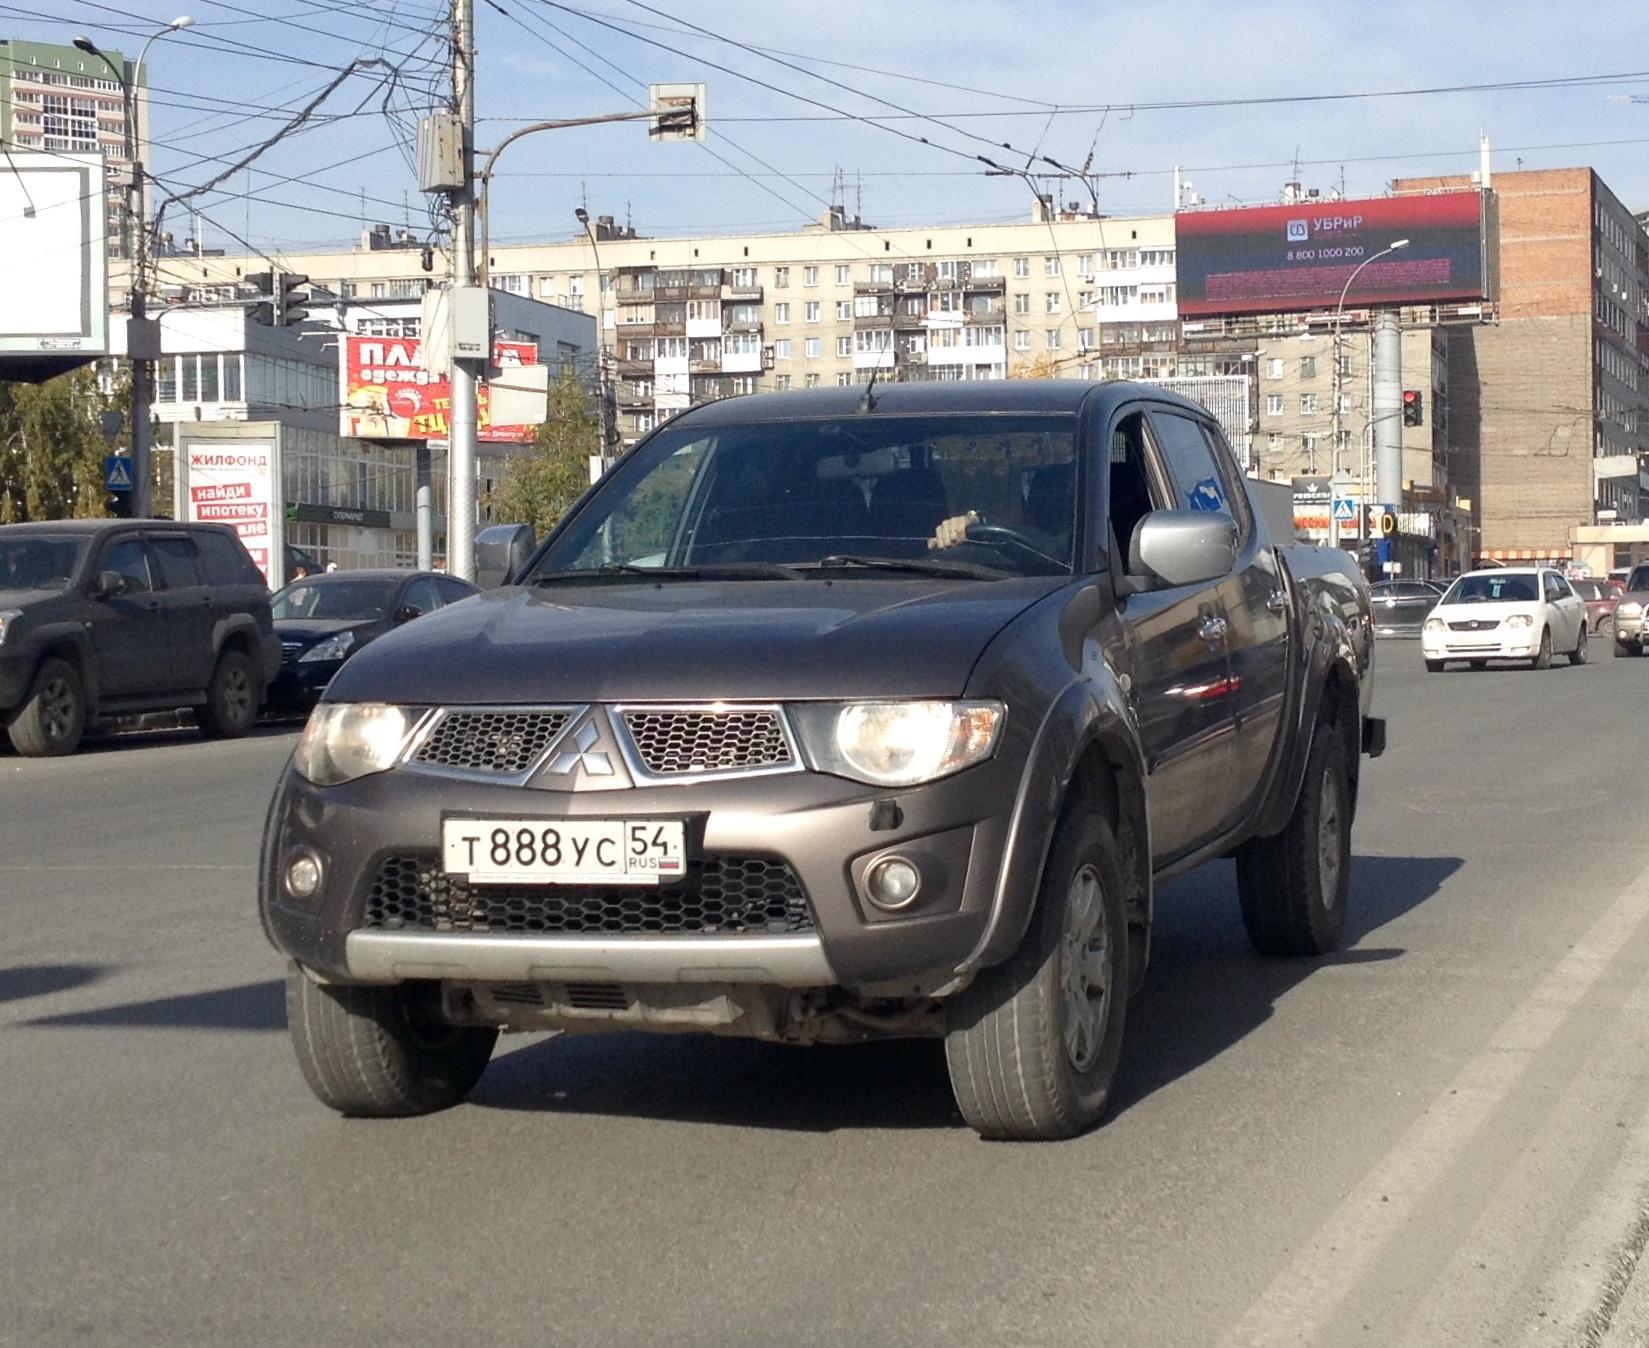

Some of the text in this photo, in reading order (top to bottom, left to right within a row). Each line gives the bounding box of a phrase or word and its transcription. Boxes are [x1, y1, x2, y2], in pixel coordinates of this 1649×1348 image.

[1314, 216, 1363, 231] УБРиР
[1287, 247, 1364, 260] 8 800 1000 200
[191, 454, 267, 467] ЖИЛФОНД
[197, 485, 246, 499] найди
[202, 505, 265, 518] ипотеку
[462, 826, 669, 867] Т888УС 54
[629, 857, 657, 869] RUS
